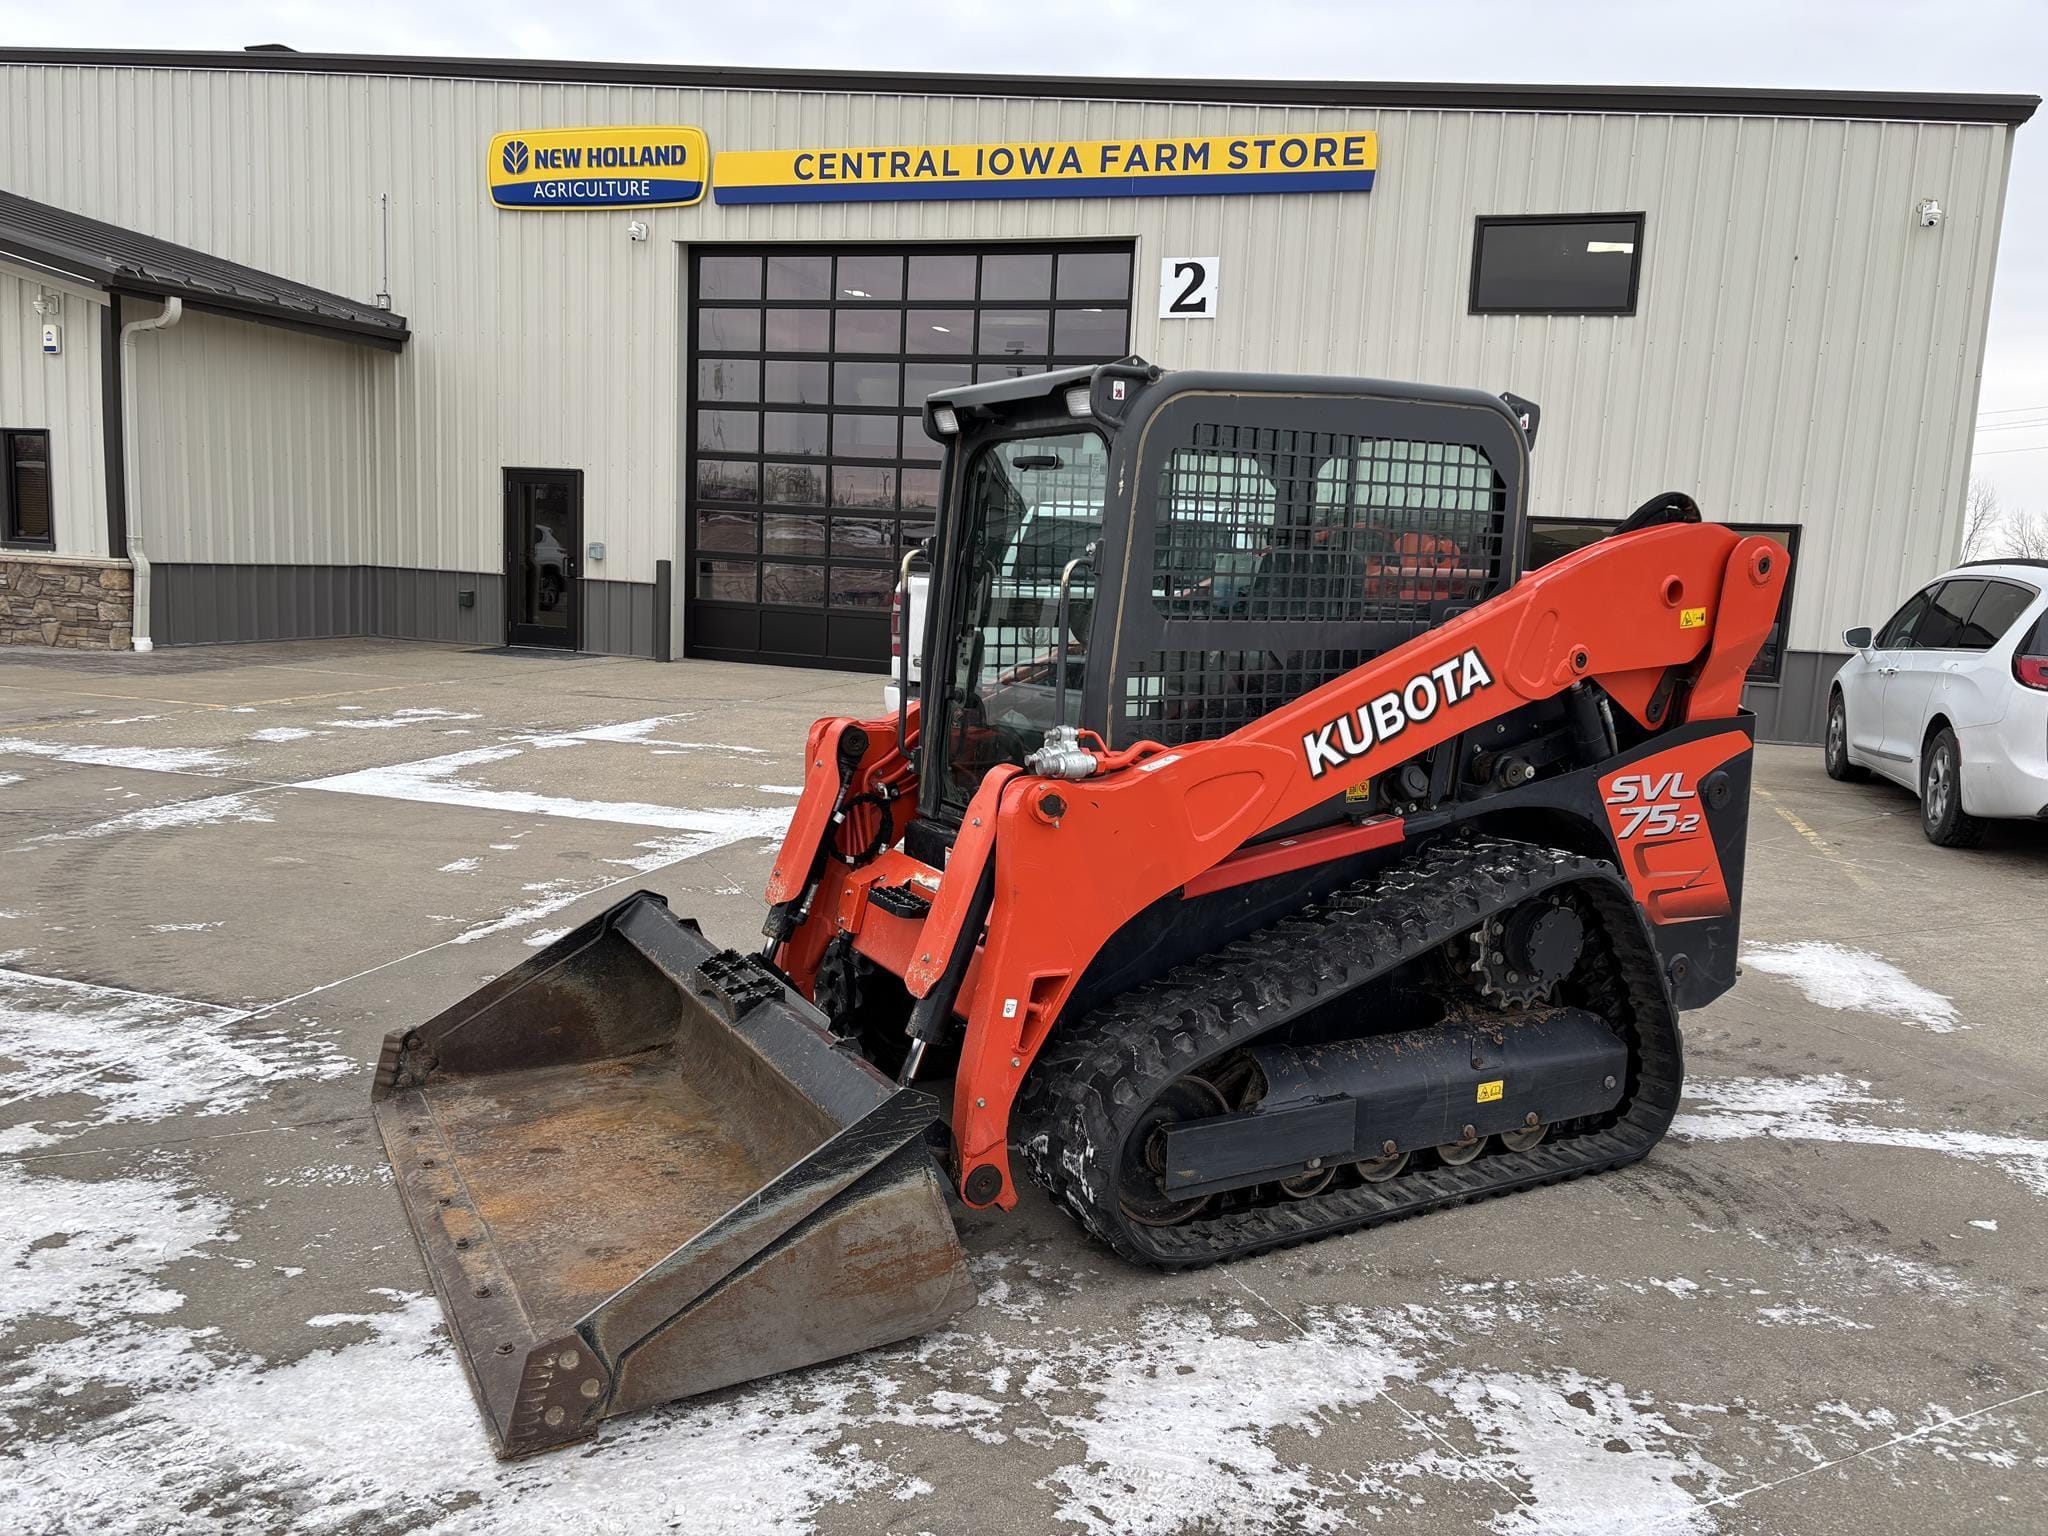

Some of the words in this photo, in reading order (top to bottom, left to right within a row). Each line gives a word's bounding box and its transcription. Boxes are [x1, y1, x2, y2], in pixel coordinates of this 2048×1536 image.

[534, 147, 582, 170] NEW
[586, 144, 687, 168] HOLLAND
[794, 149, 960, 181] CENTRAL
[976, 146, 1083, 176] IOWA
[1100, 142, 1210, 173] FARM
[1227, 136, 1366, 170] STORE
[533, 180, 651, 199] AGRICULTURE
[1169, 261, 1206, 313] 2
[1303, 646, 1493, 778] KUBOTA
[1606, 771, 1696, 804] SVL
[1617, 804, 1701, 840] 75-2
